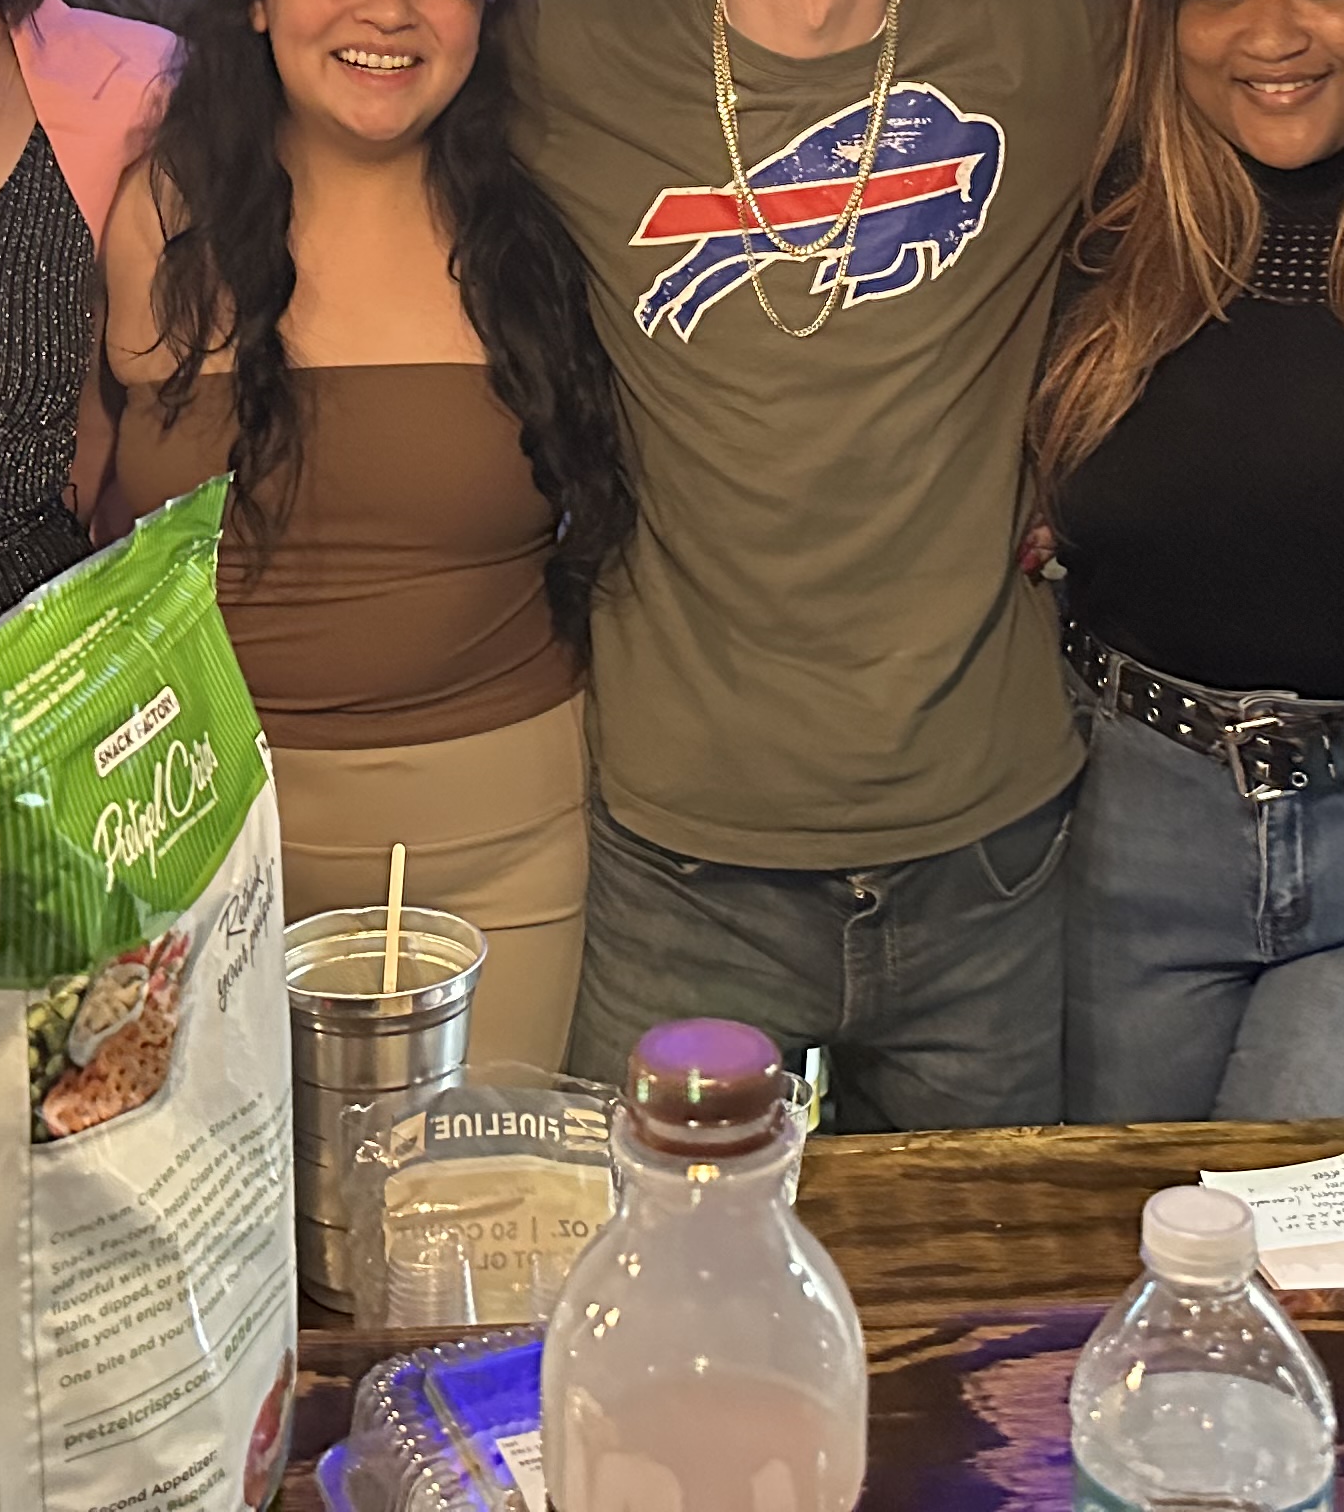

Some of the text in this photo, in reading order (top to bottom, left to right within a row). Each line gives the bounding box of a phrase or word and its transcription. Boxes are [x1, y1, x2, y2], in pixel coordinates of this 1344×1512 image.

[98, 732, 134, 768] SNACK
[134, 693, 176, 739] FACTORY
[93, 761, 167, 893] Pretzel
[219, 1166, 235, 1191] part
[51, 1247, 94, 1275] Snack
[51, 1277, 114, 1316] flavorful
[119, 1263, 151, 1285] with
[155, 1250, 180, 1268] the
[98, 1284, 153, 1318] dipped,
[157, 1275, 172, 1289] or
[56, 1296, 173, 1358] sure you'll enjoy
[59, 1369, 91, 1389] One
[97, 1354, 125, 1375] bite
[129, 1337, 155, 1359] and
[152, 1449, 217, 1496] Appetizer:
